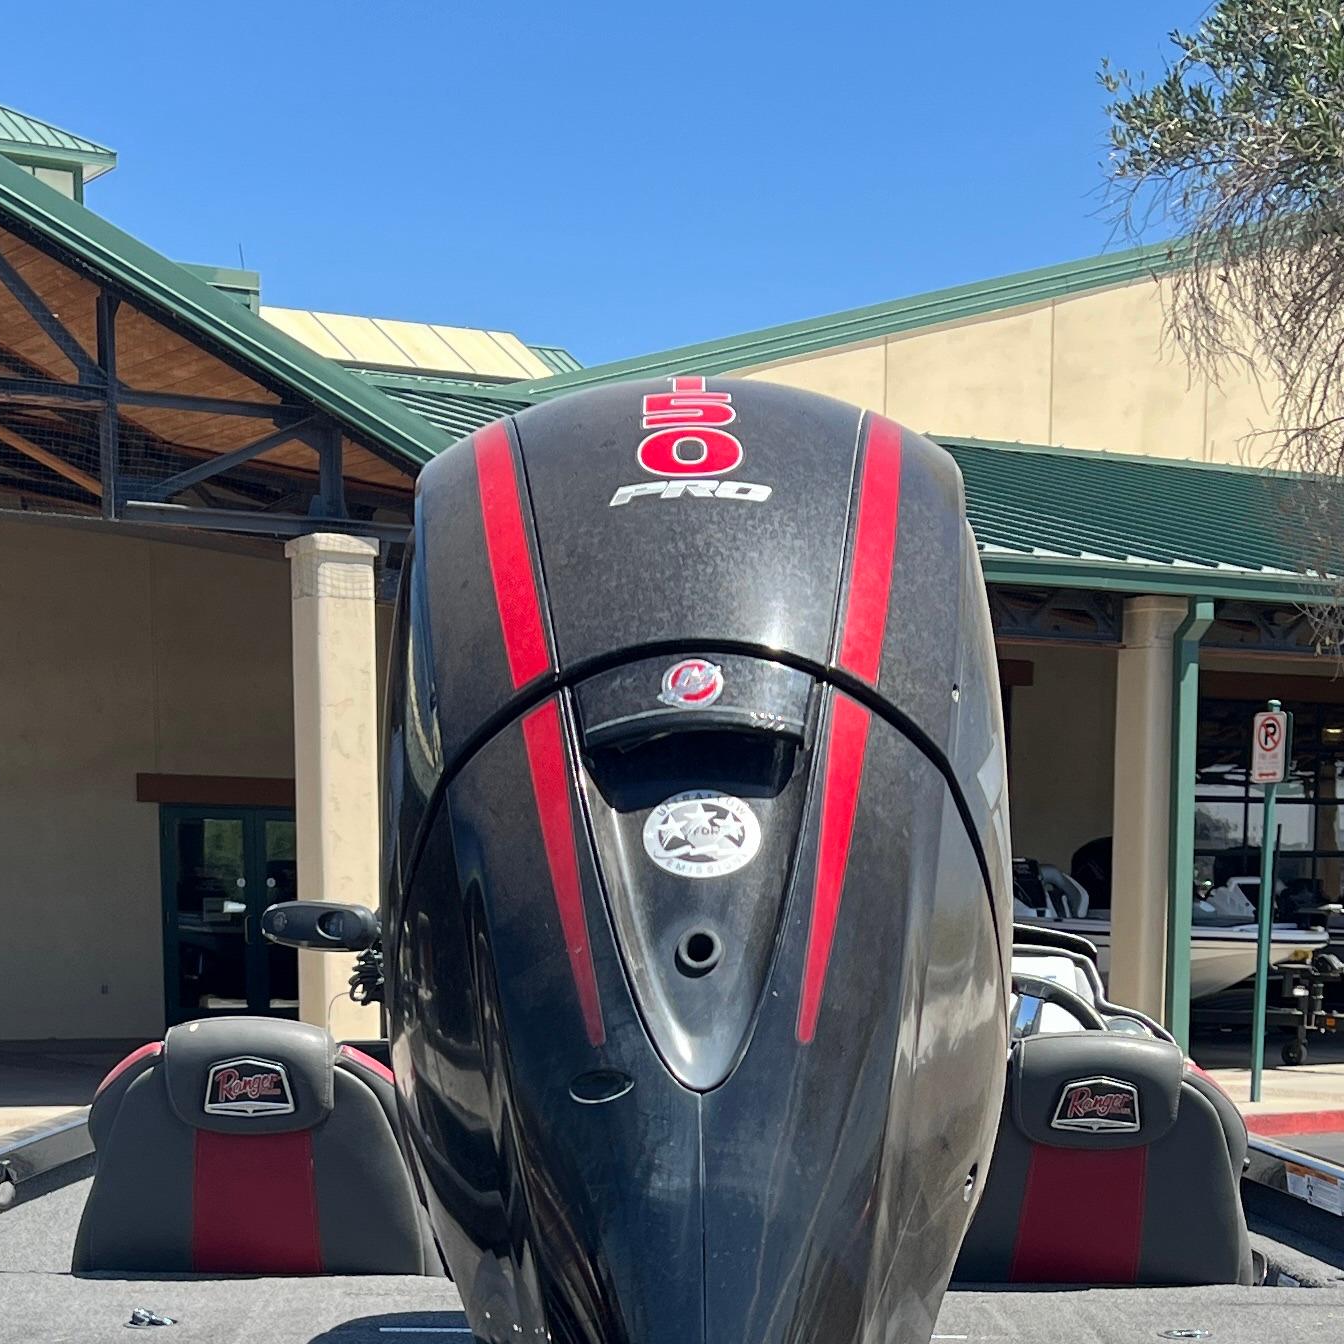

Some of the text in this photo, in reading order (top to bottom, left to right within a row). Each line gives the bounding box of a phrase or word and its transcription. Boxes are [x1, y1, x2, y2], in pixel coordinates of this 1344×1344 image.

[609, 479, 773, 507] PRO
[214, 1068, 283, 1103] Ranger
[1067, 1086, 1134, 1118] Ranger
